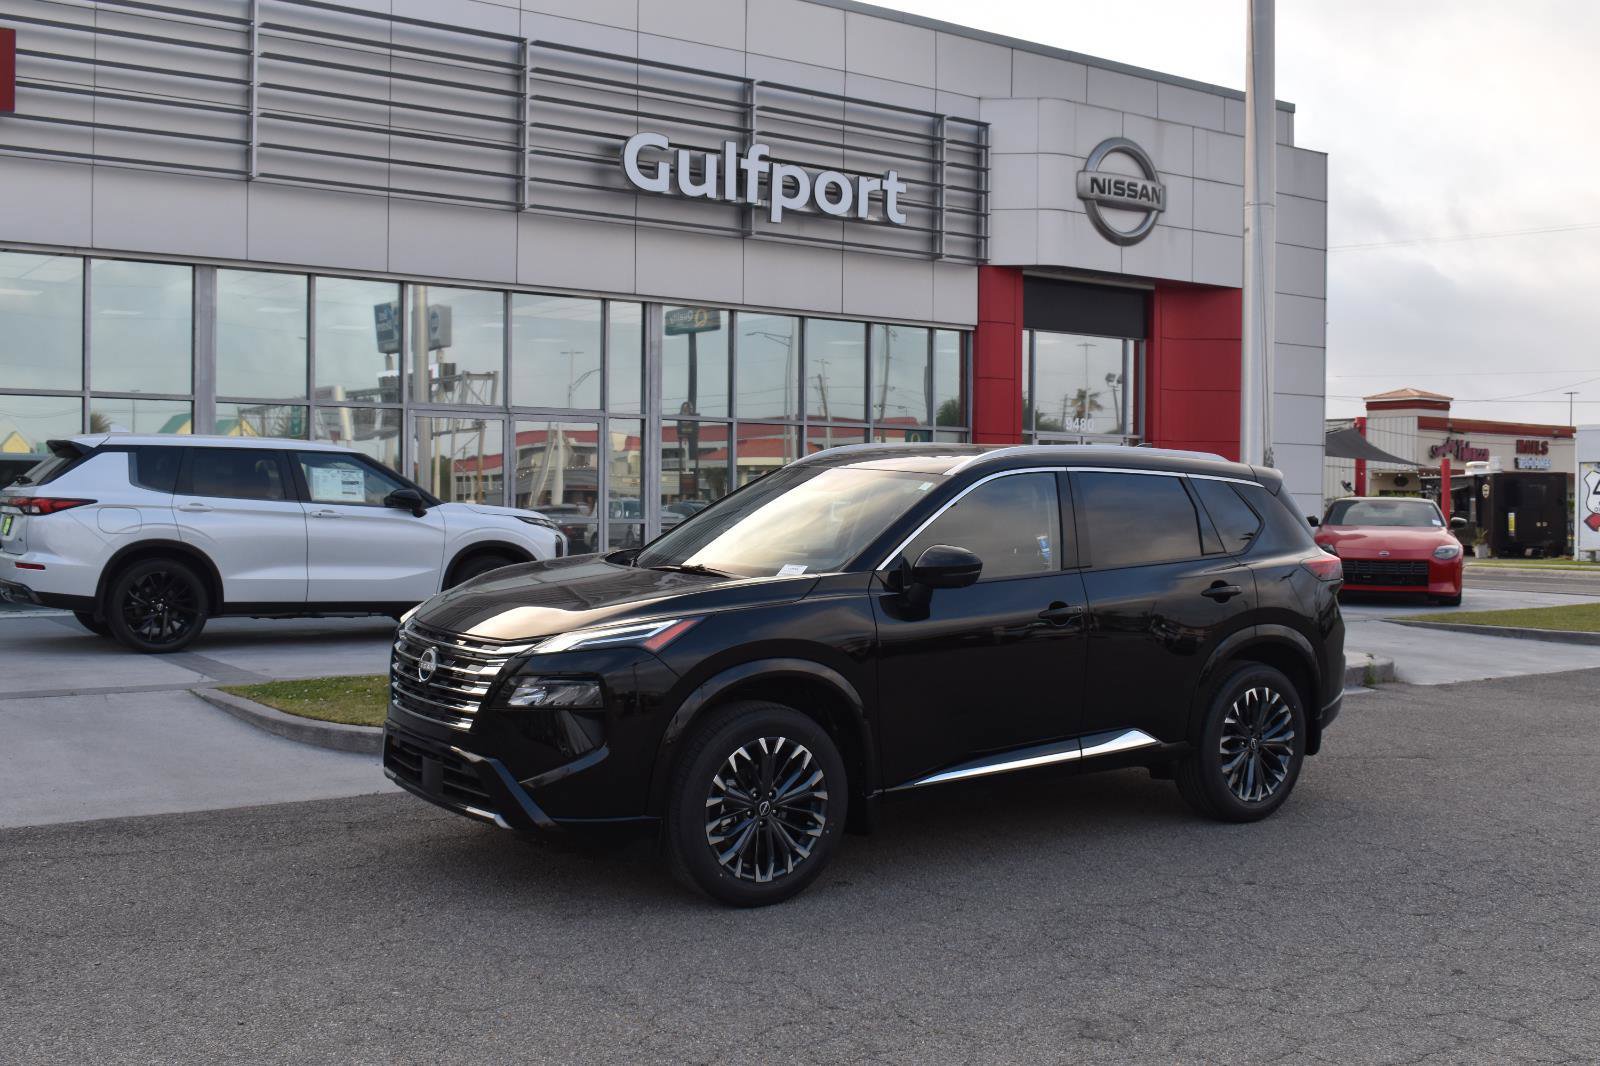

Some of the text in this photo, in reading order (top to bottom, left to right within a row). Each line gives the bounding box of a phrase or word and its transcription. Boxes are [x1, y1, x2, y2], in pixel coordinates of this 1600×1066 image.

[622, 132, 907, 225] Gulfport
[1090, 177, 1162, 205] NISSAN
[1065, 417, 1094, 432] 9480
